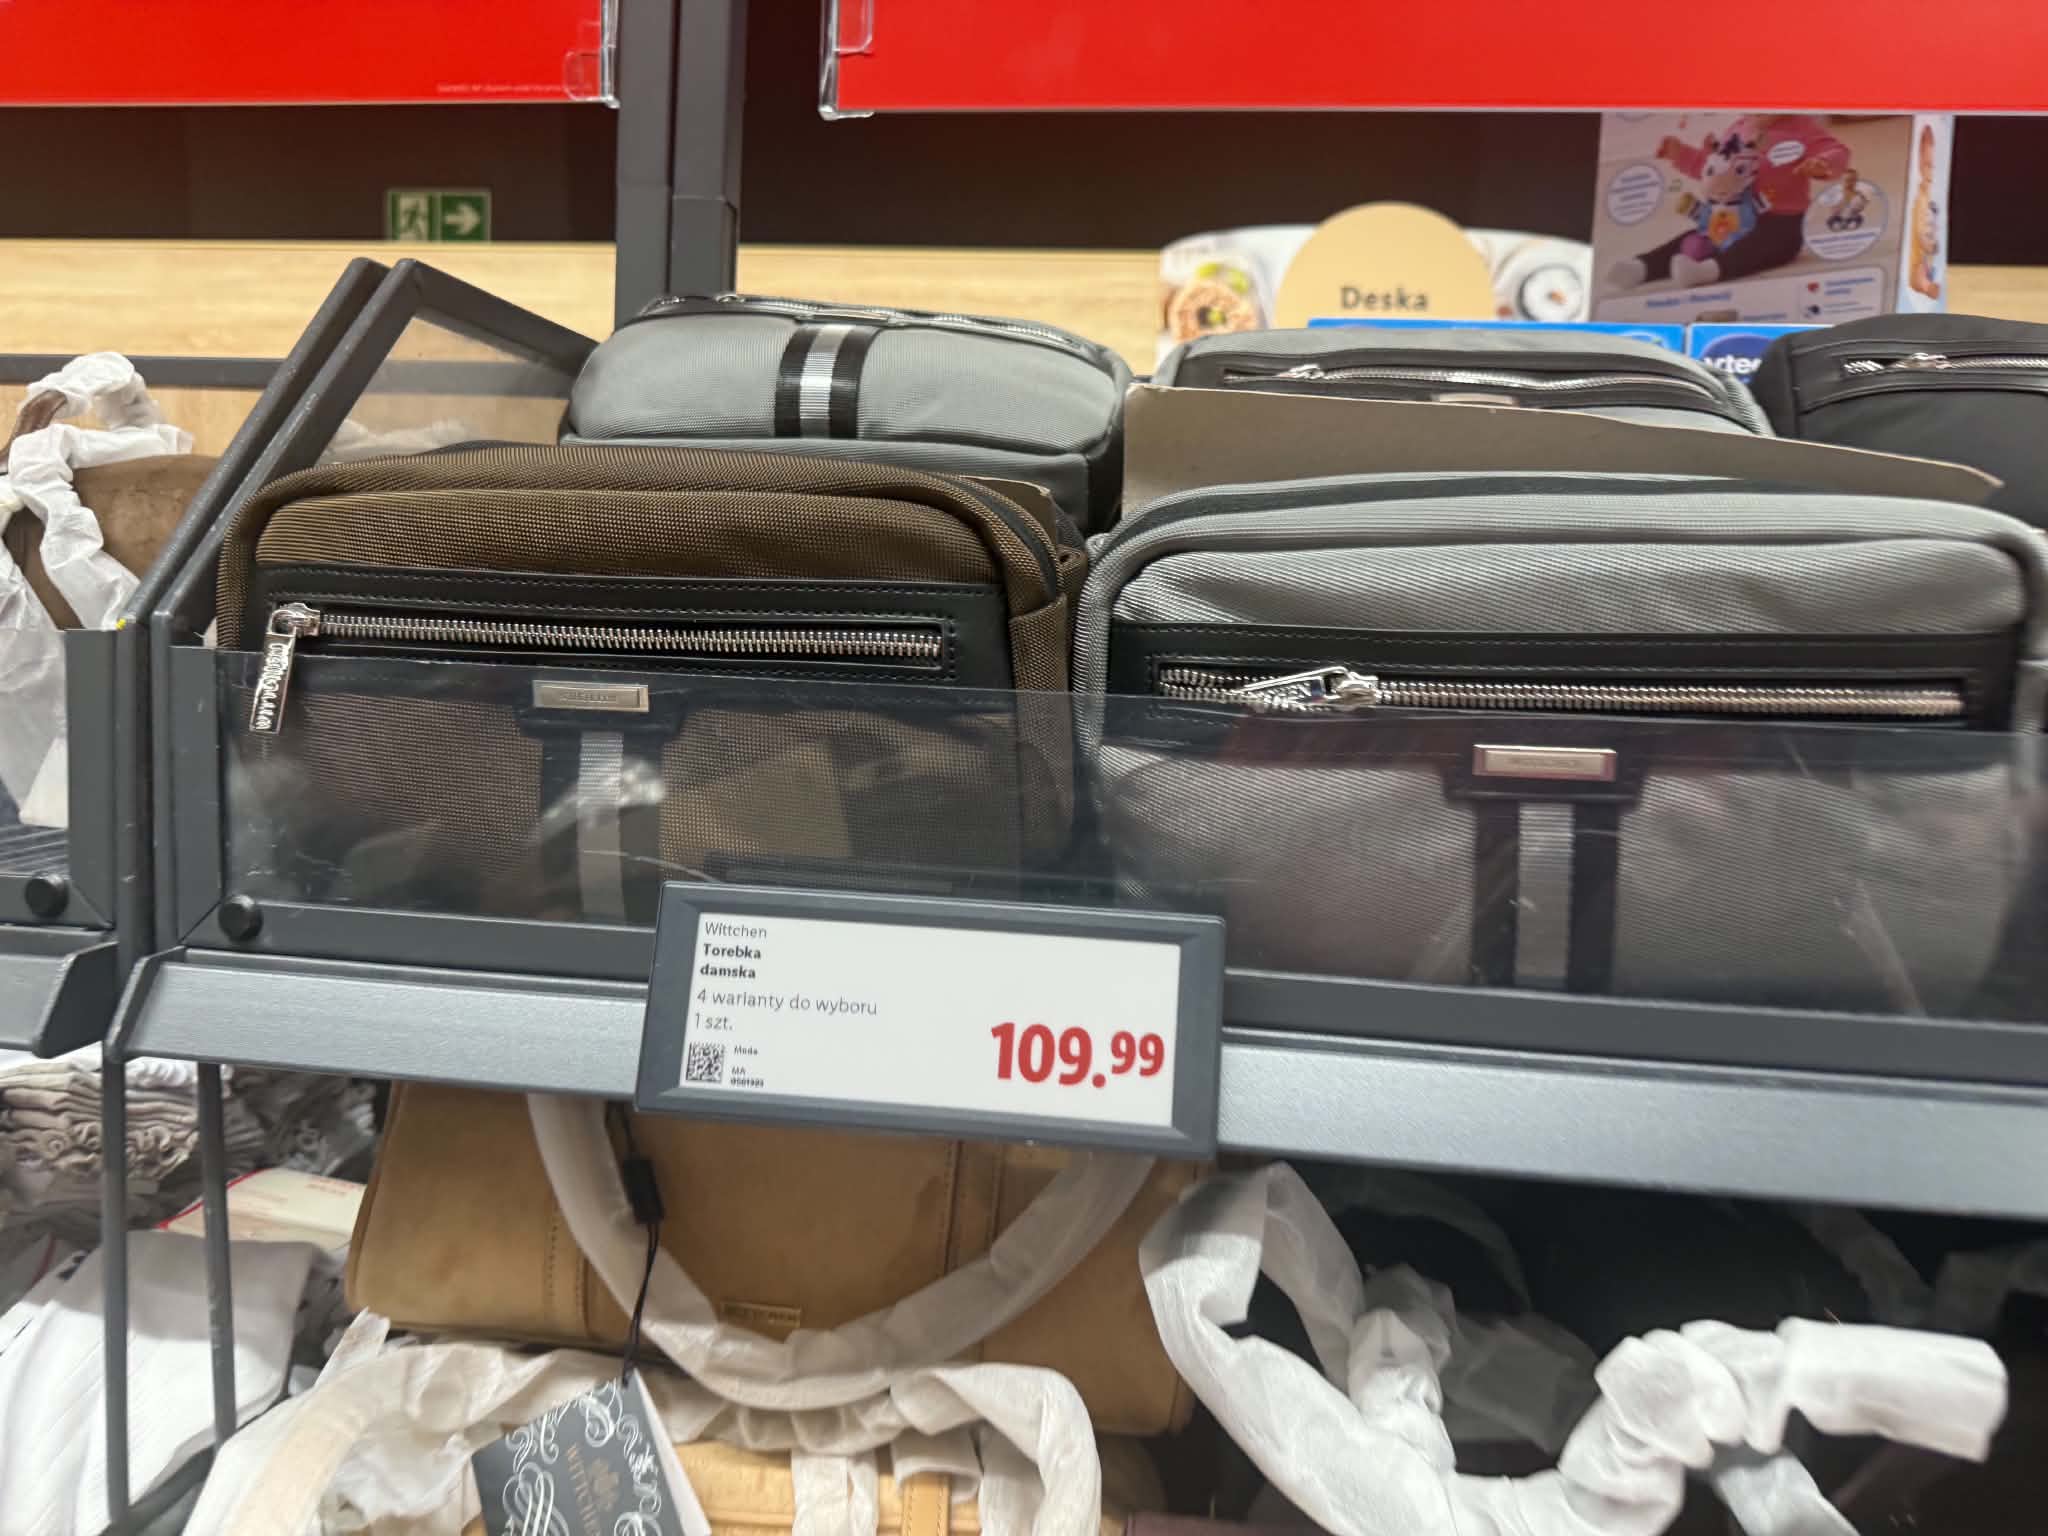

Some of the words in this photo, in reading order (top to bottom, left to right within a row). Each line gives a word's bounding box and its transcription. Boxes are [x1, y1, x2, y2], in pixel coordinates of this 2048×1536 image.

[1340, 285, 1429, 311] Deska
[704, 921, 767, 939] Wittchen
[703, 943, 762, 959] Torebka
[700, 963, 757, 979] damska
[697, 988, 707, 1004] 4
[712, 990, 784, 1011] warianty
[789, 992, 811, 1011] do
[816, 995, 878, 1016] wyboru
[695, 1012, 701, 1029] 1
[705, 1015, 734, 1031] szt.
[991, 1021, 1165, 1089] 109.99
